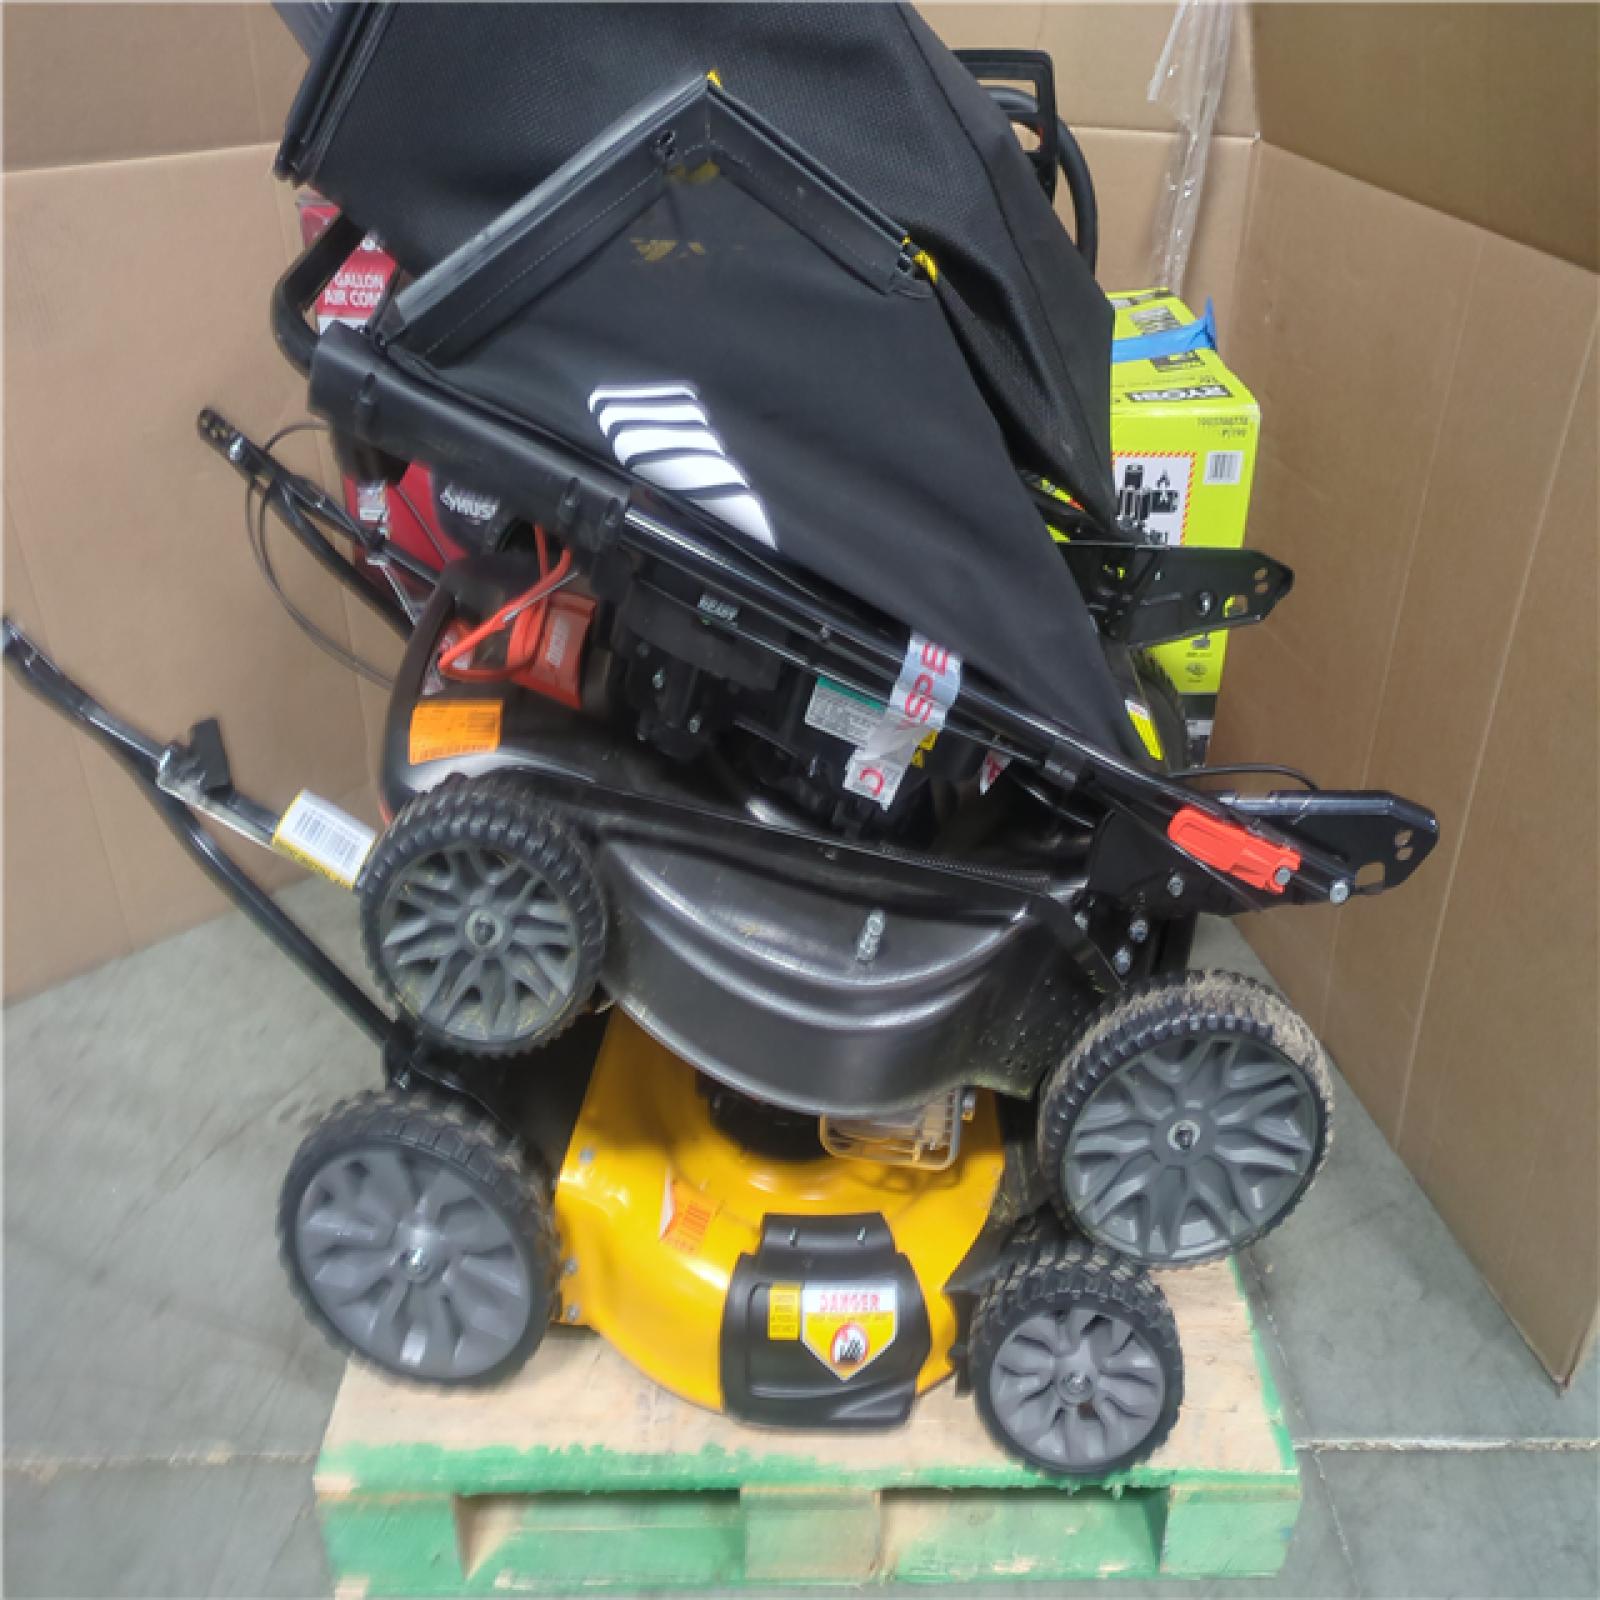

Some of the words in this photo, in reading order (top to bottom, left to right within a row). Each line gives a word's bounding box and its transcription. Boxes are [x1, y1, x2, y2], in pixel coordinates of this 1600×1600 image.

[333, 272, 385, 289] GALLON
[325, 289, 348, 306] AIR
[819, 1292, 881, 1312] DANGER
